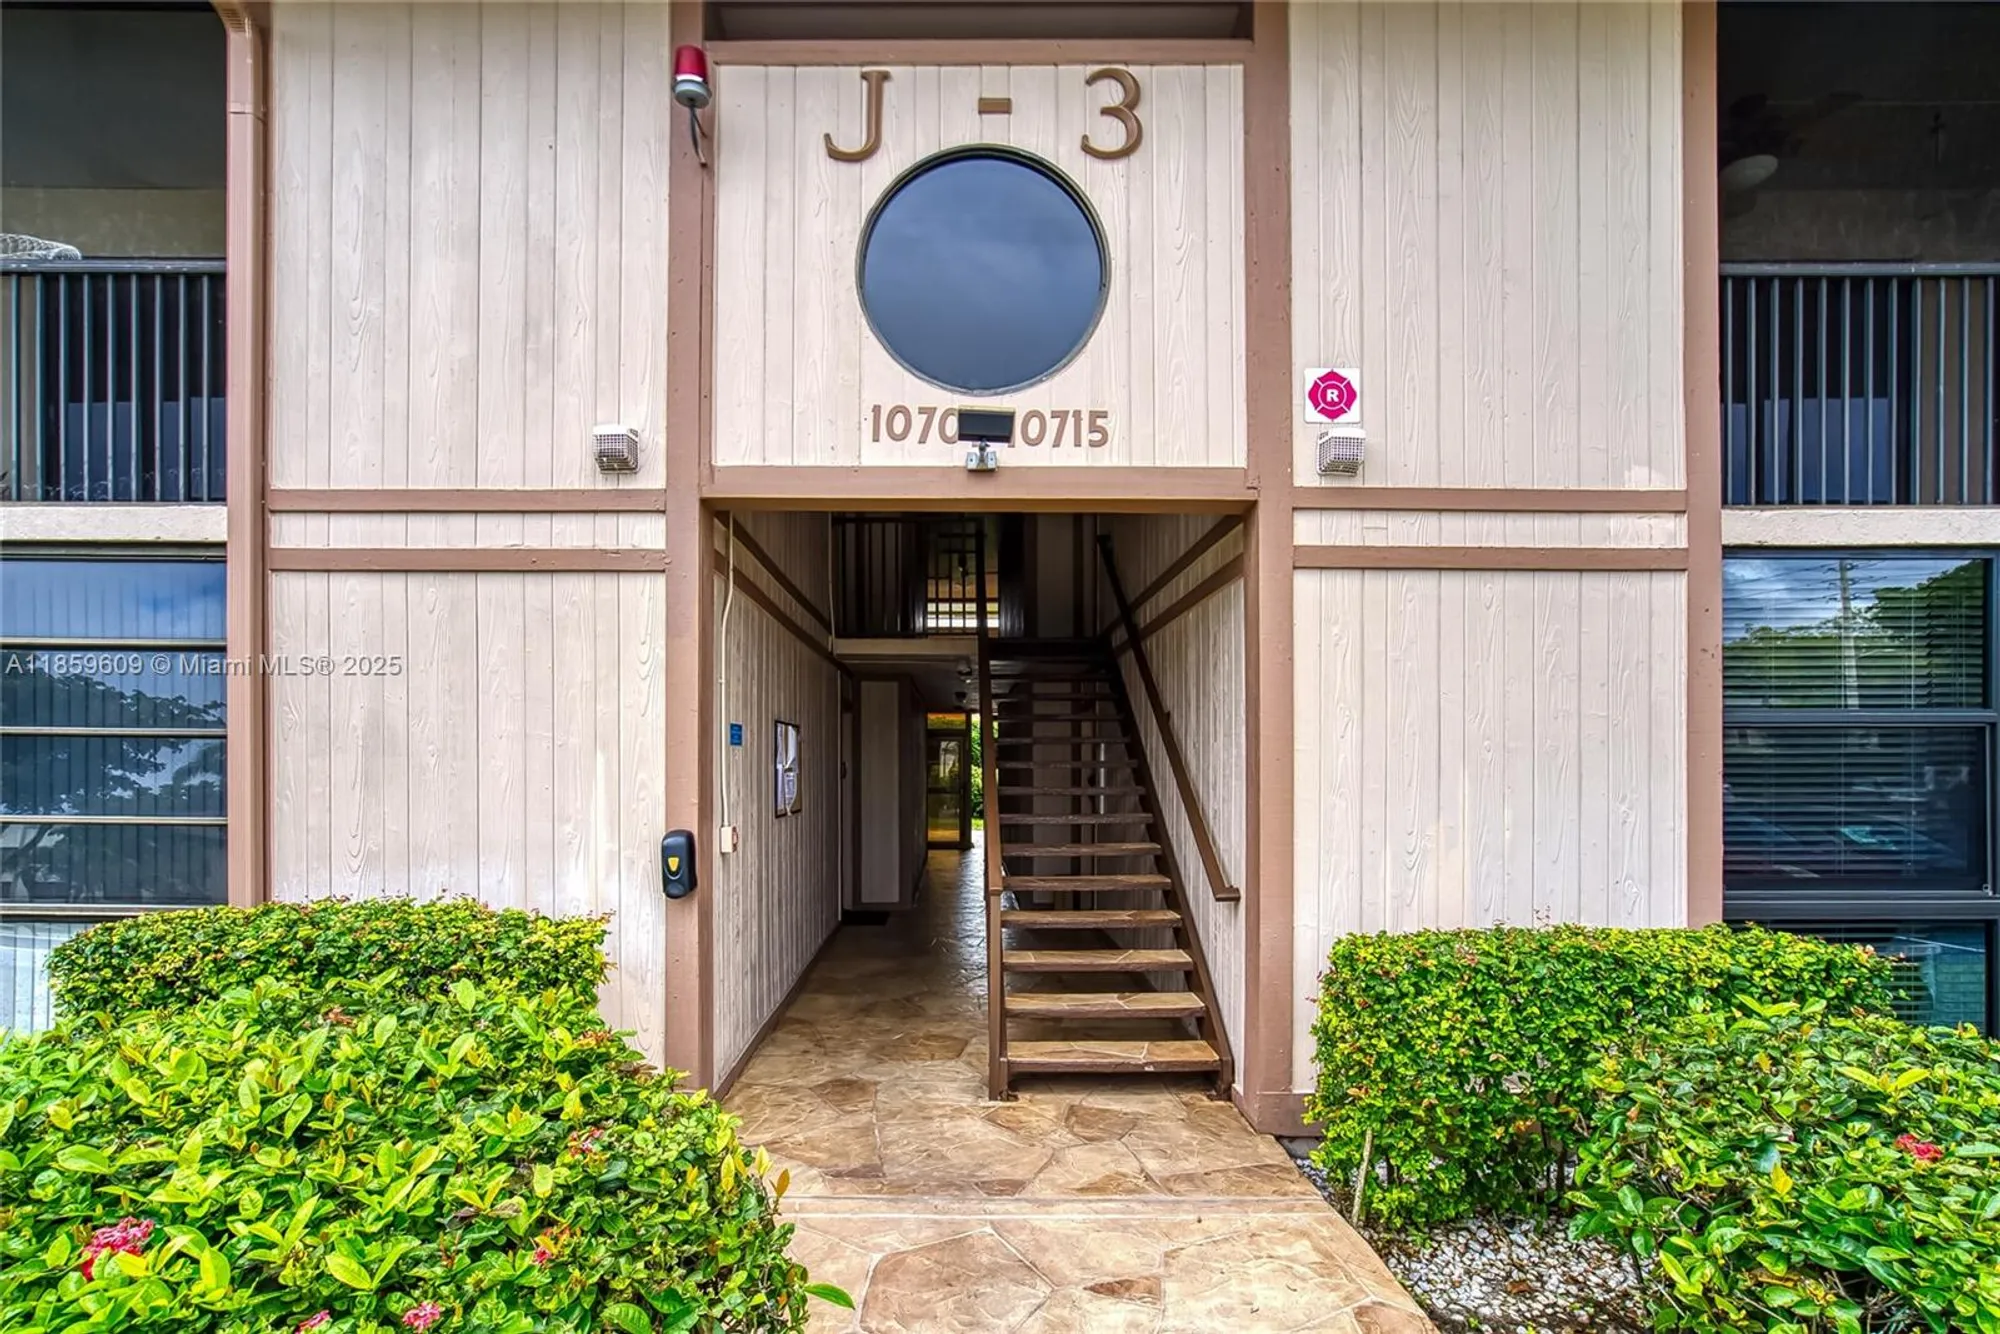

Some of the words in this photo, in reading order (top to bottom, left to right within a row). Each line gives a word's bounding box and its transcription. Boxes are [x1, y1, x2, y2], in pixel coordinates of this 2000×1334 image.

[824, 70, 891, 162] J
[1080, 67, 1143, 160] 3
[1326, 388, 1340, 402] R
[872, 404, 980, 448] 1070
[1007, 408, 1110, 448] 0715
